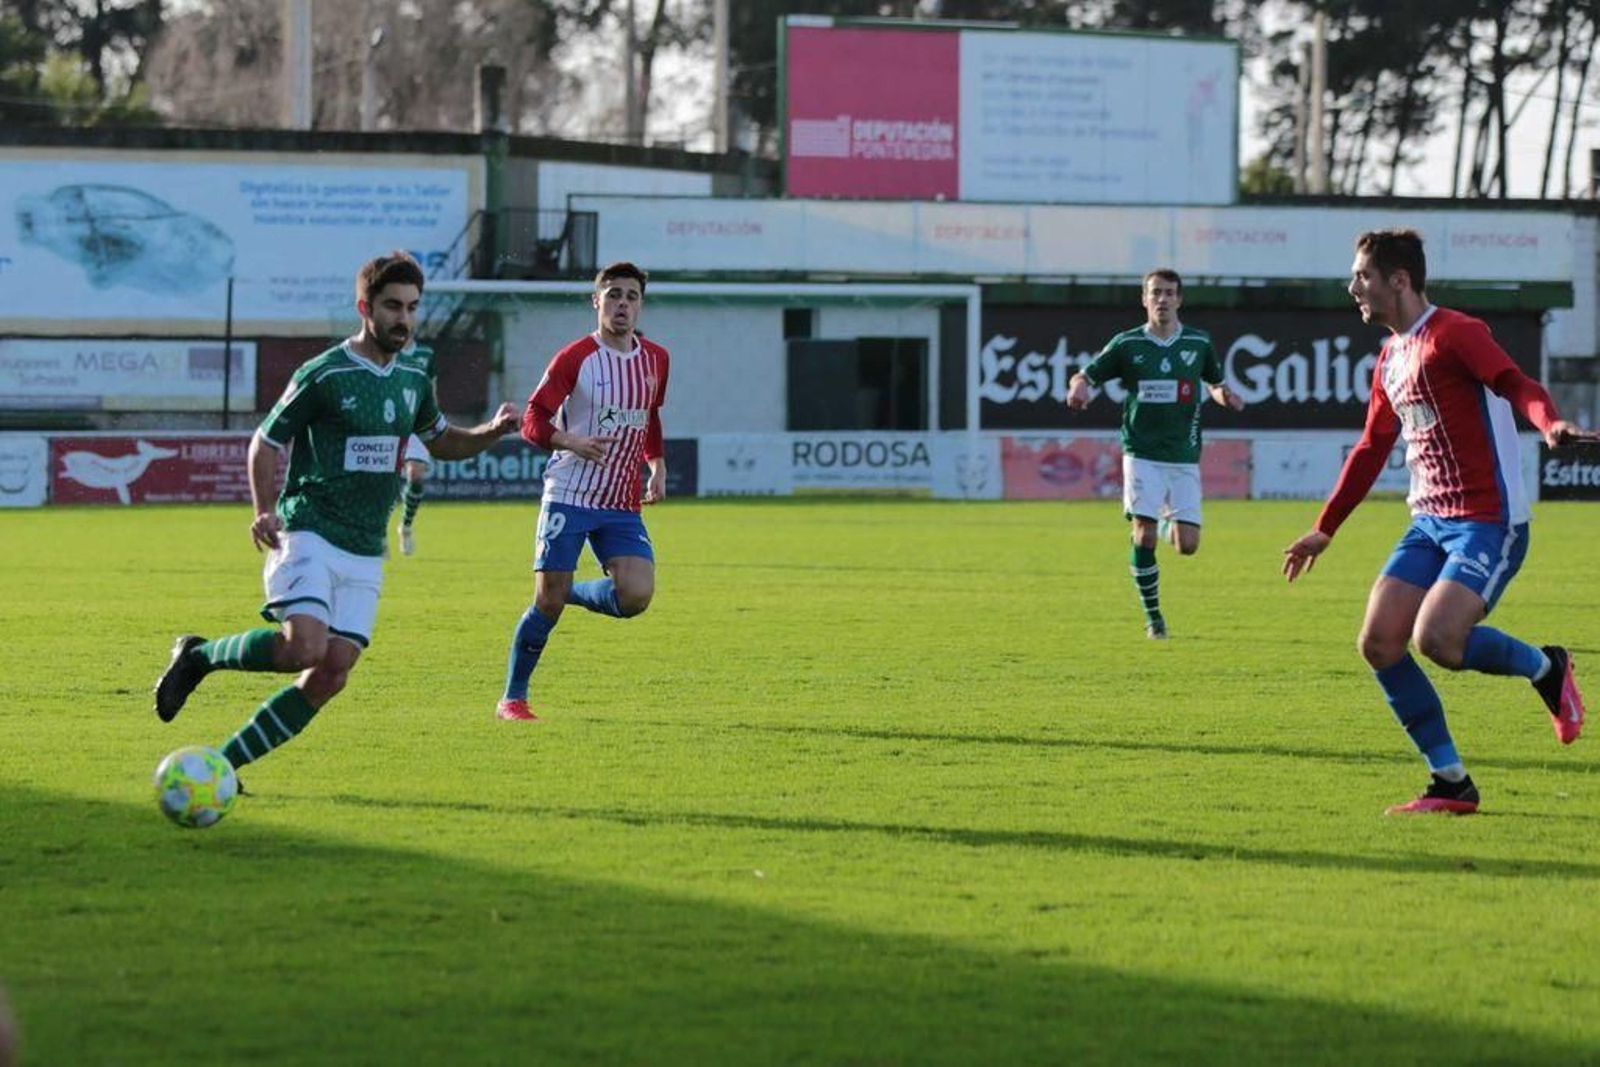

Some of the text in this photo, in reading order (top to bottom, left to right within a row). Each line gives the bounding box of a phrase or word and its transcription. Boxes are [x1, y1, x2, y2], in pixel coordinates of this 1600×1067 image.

[853, 118, 954, 141] DEPUTACIÓN
[74, 352, 159, 372] MEGA
[1159, 357, 1172, 373] 6
[1224, 334, 1388, 404] Galic
[383, 398, 396, 424] 8
[792, 441, 931, 467] RODOSA
